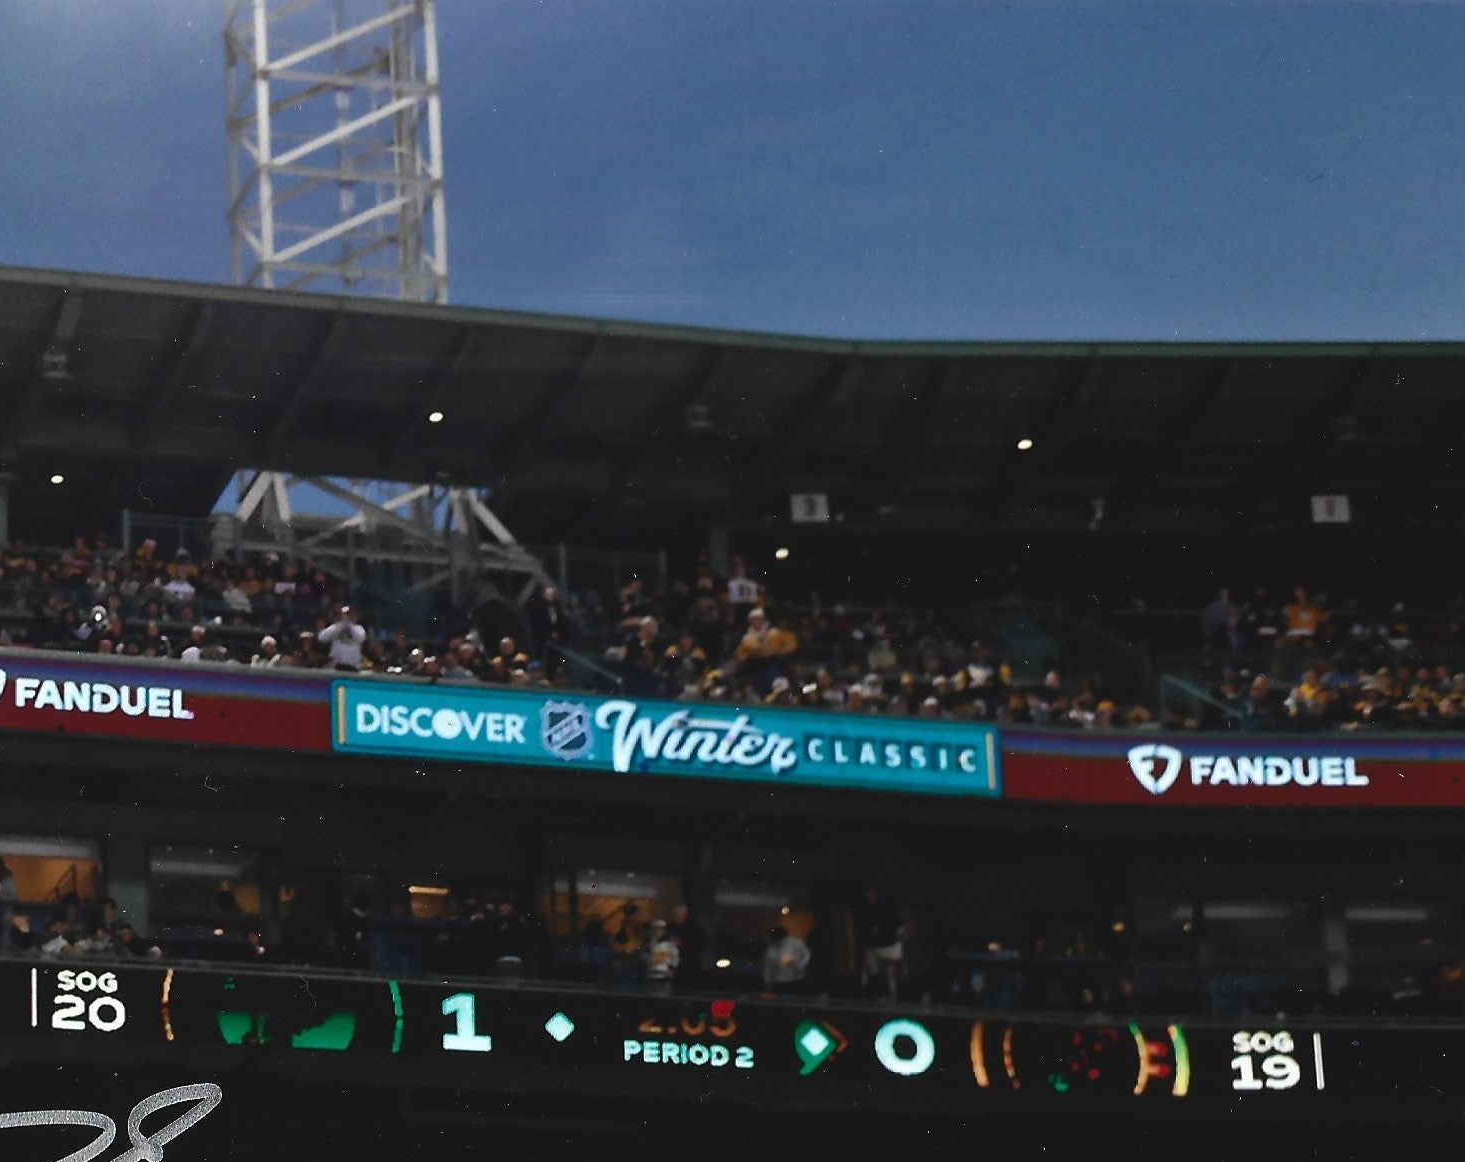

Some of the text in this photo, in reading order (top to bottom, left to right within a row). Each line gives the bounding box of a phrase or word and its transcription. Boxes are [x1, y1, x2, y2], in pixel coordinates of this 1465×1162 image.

[14, 676, 196, 721] FANDUEL
[356, 703, 527, 744] DISCOVER
[595, 700, 797, 774] Winter
[805, 738, 978, 774] CLASSIC
[1188, 756, 1370, 787] FANDUEL
[57, 971, 118, 993] SOG
[51, 995, 126, 1032] 20
[442, 993, 492, 1052] 1
[623, 1039, 754, 1068] PERIOD 2
[874, 1019, 935, 1077] 0
[1232, 1031, 1294, 1053] SOG
[1231, 1055, 1301, 1090] 19
